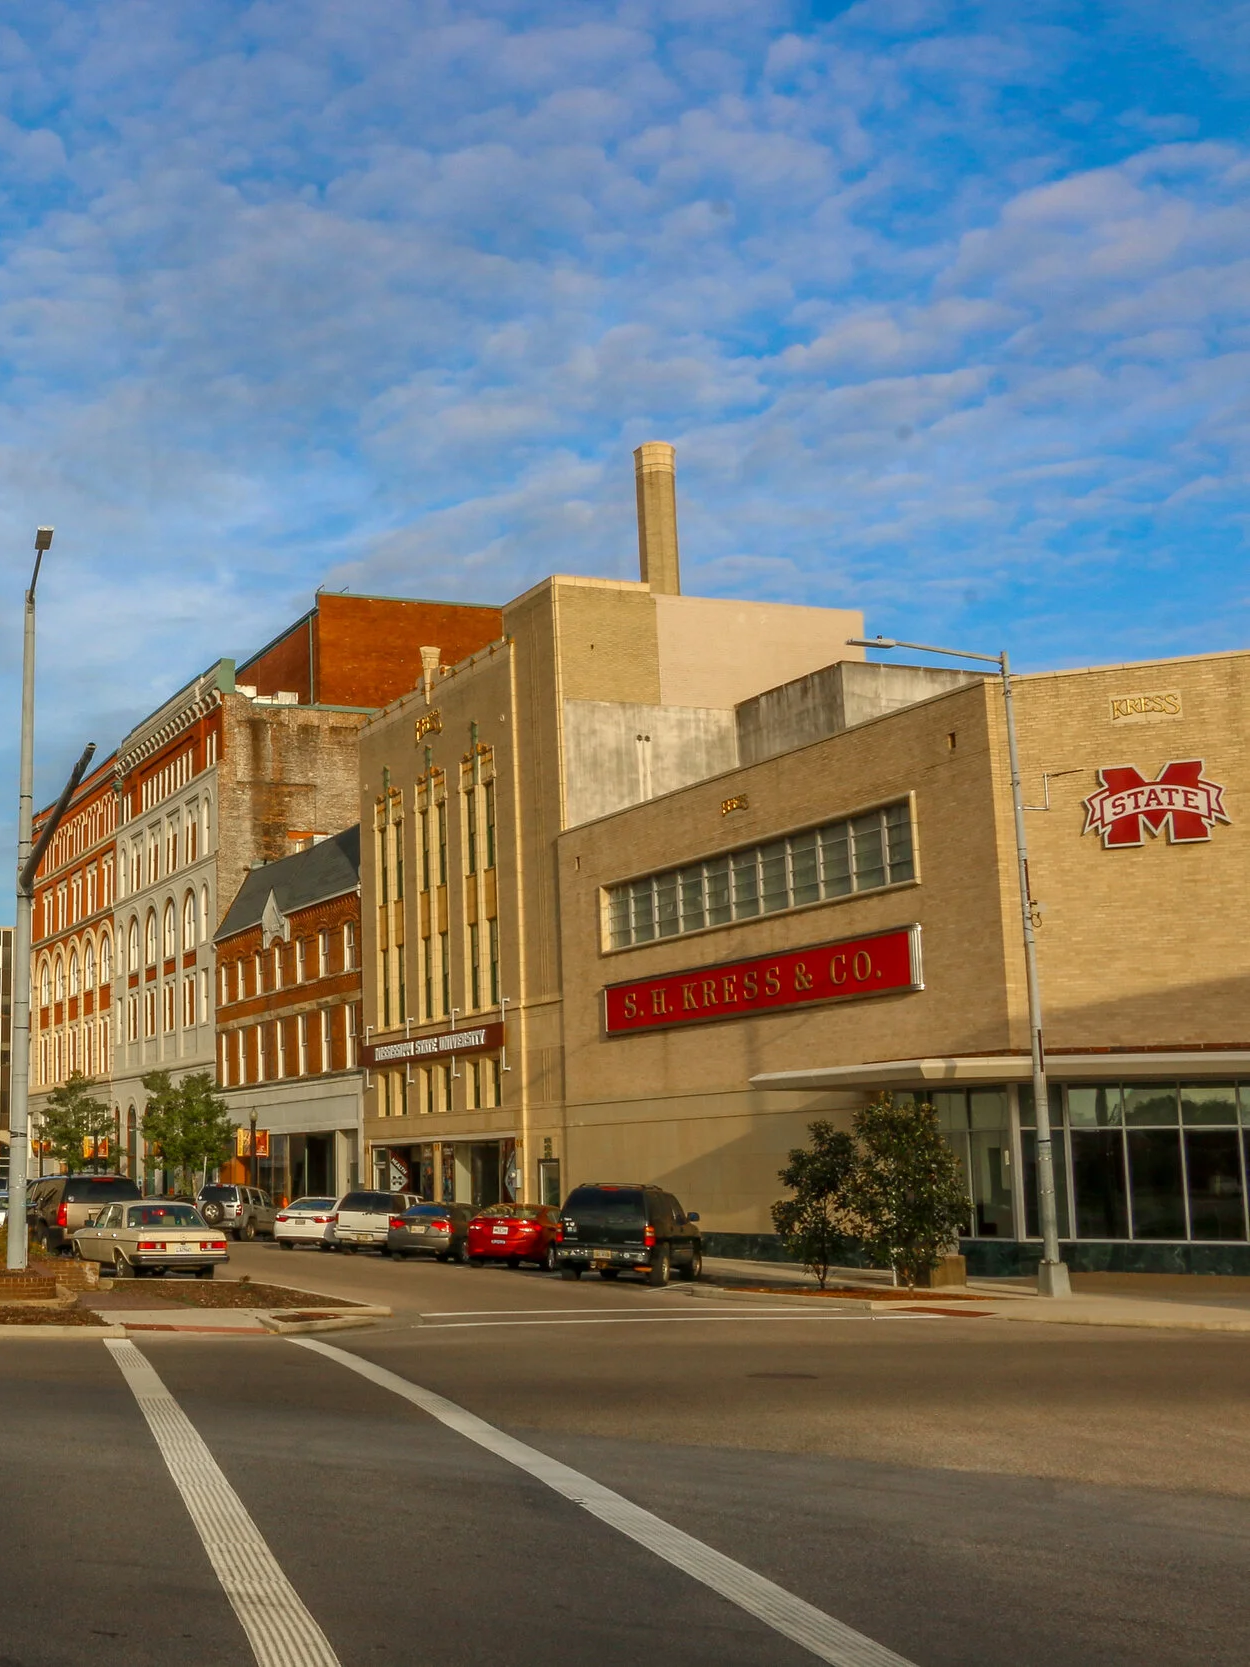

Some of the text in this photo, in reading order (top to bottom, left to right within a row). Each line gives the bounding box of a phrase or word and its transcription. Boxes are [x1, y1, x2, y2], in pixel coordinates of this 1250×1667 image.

[1111, 694, 1182, 720] KRESS
[1111, 788, 1200, 817] STATE
[624, 951, 882, 1019] S. H. KRESS & CO.
[415, 1038, 438, 1054] STATE
